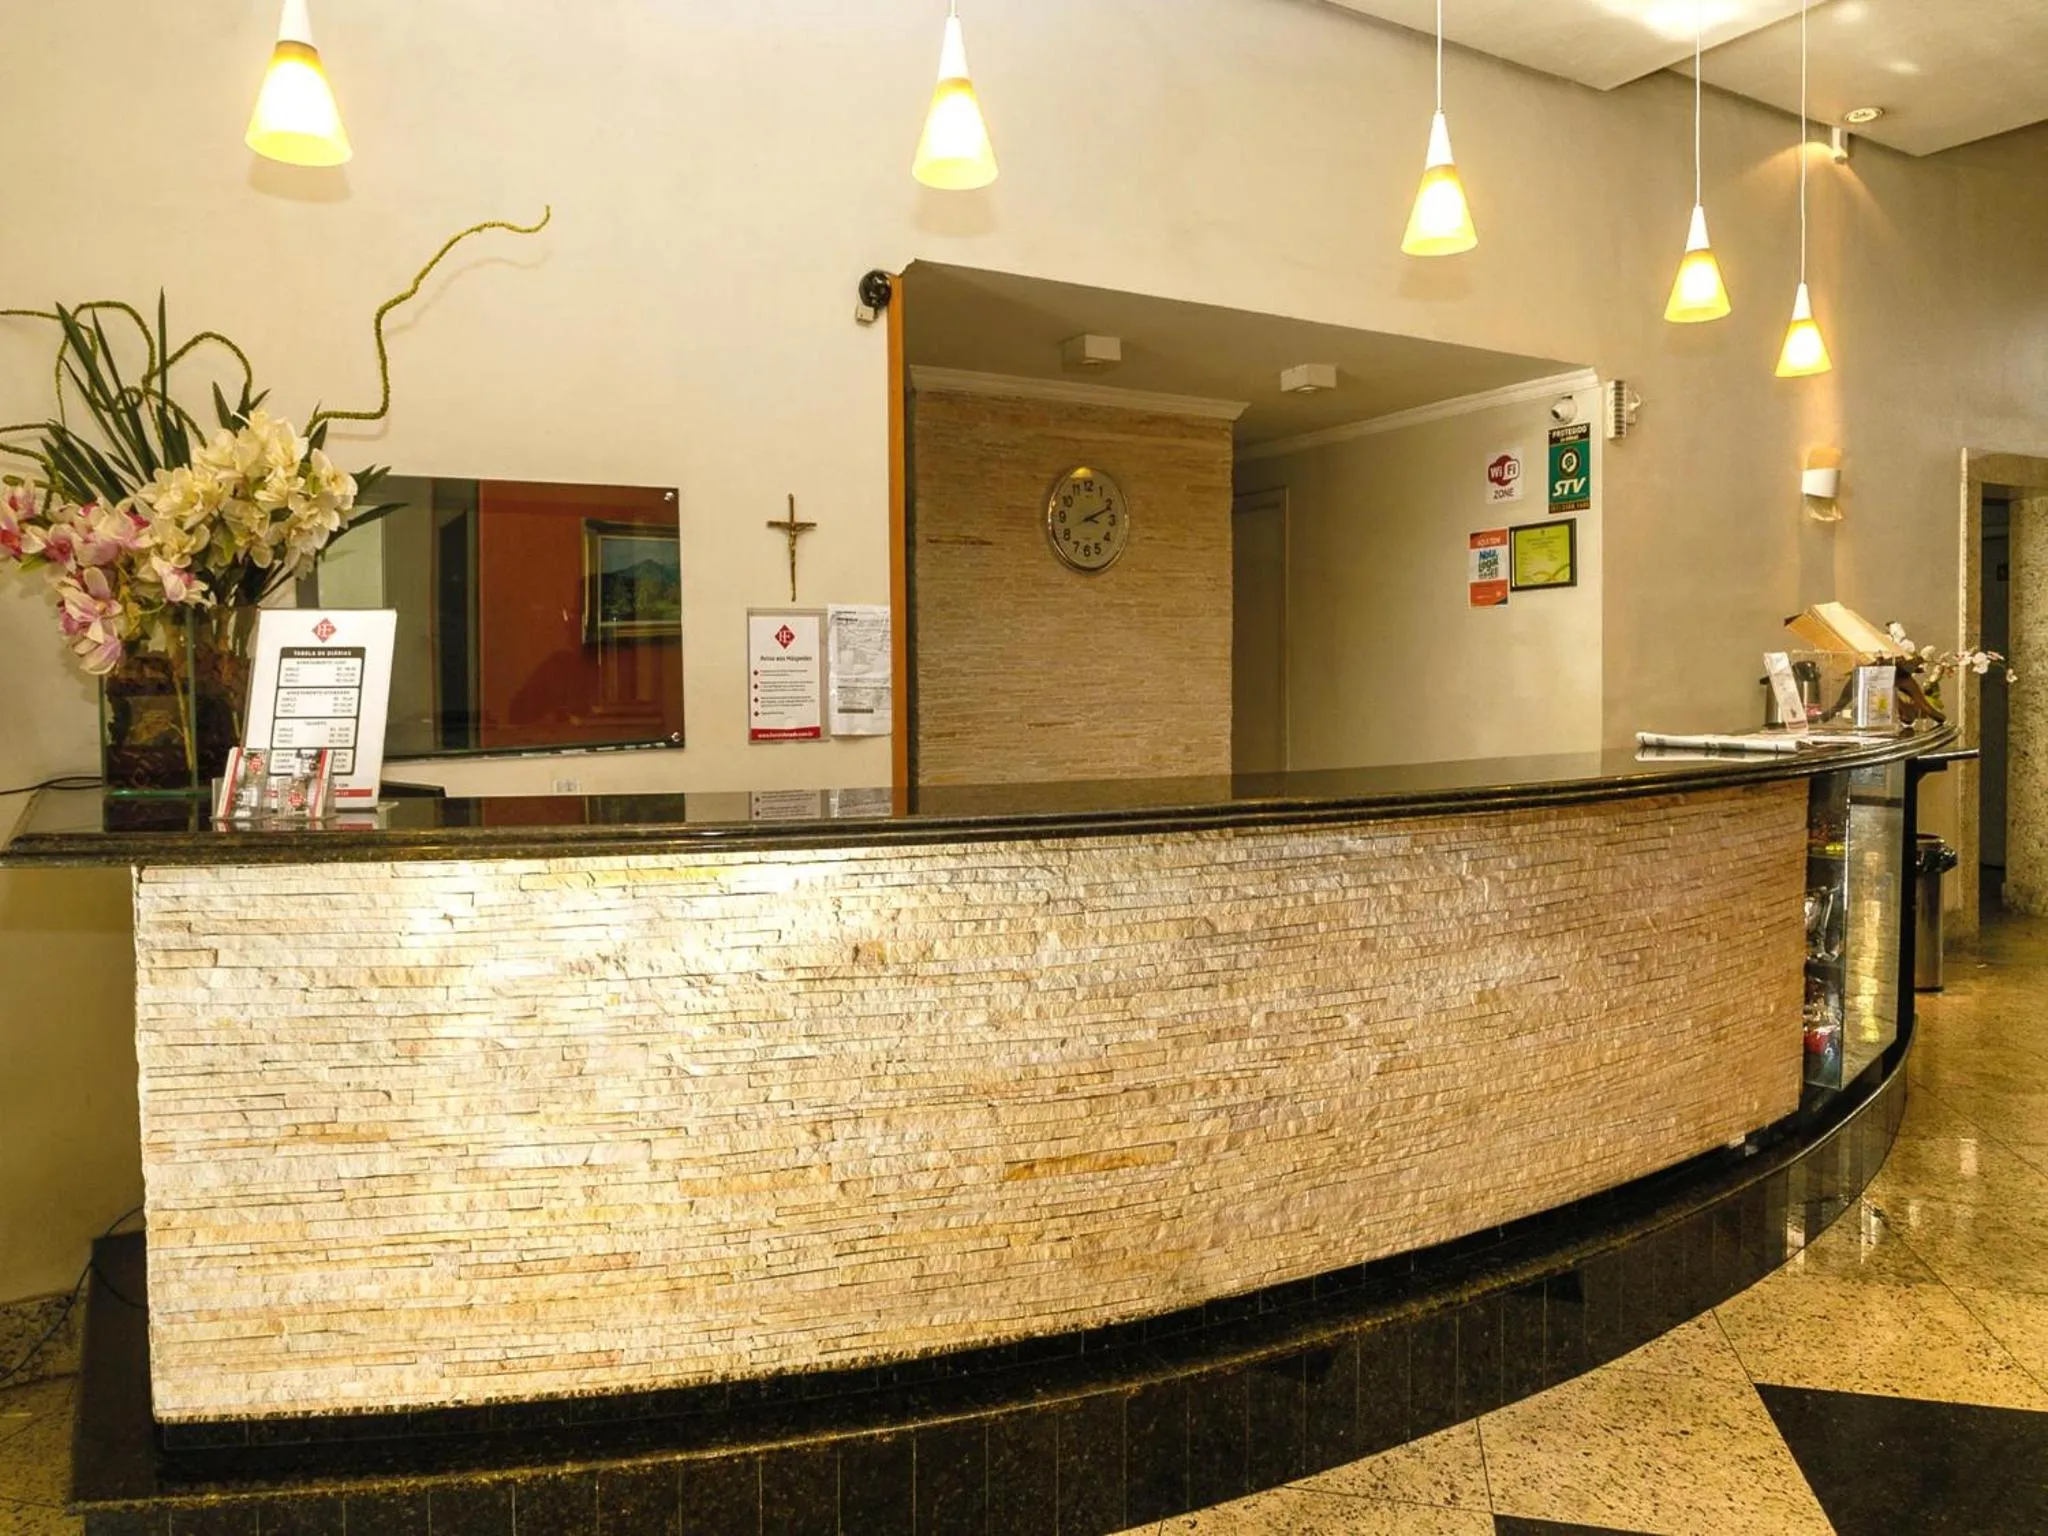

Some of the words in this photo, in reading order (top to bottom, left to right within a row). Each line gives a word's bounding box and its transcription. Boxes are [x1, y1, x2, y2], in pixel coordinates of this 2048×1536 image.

[1072, 484, 1080, 496] 11
[1084, 480, 1094, 492] 12
[1099, 486, 1103, 496] 1
[1553, 477, 1586, 496] STV
[1493, 487, 1515, 499] ZONE
[1063, 496, 1073, 508] 10
[1106, 499, 1112, 511] 2
[1059, 511, 1066, 523] 9
[1108, 514, 1116, 526] 3
[1063, 529, 1071, 541] 8
[1104, 532, 1111, 542] 4
[1073, 541, 1080, 553] 7
[1084, 545, 1091, 557] 6
[1094, 543, 1101, 555] 5
